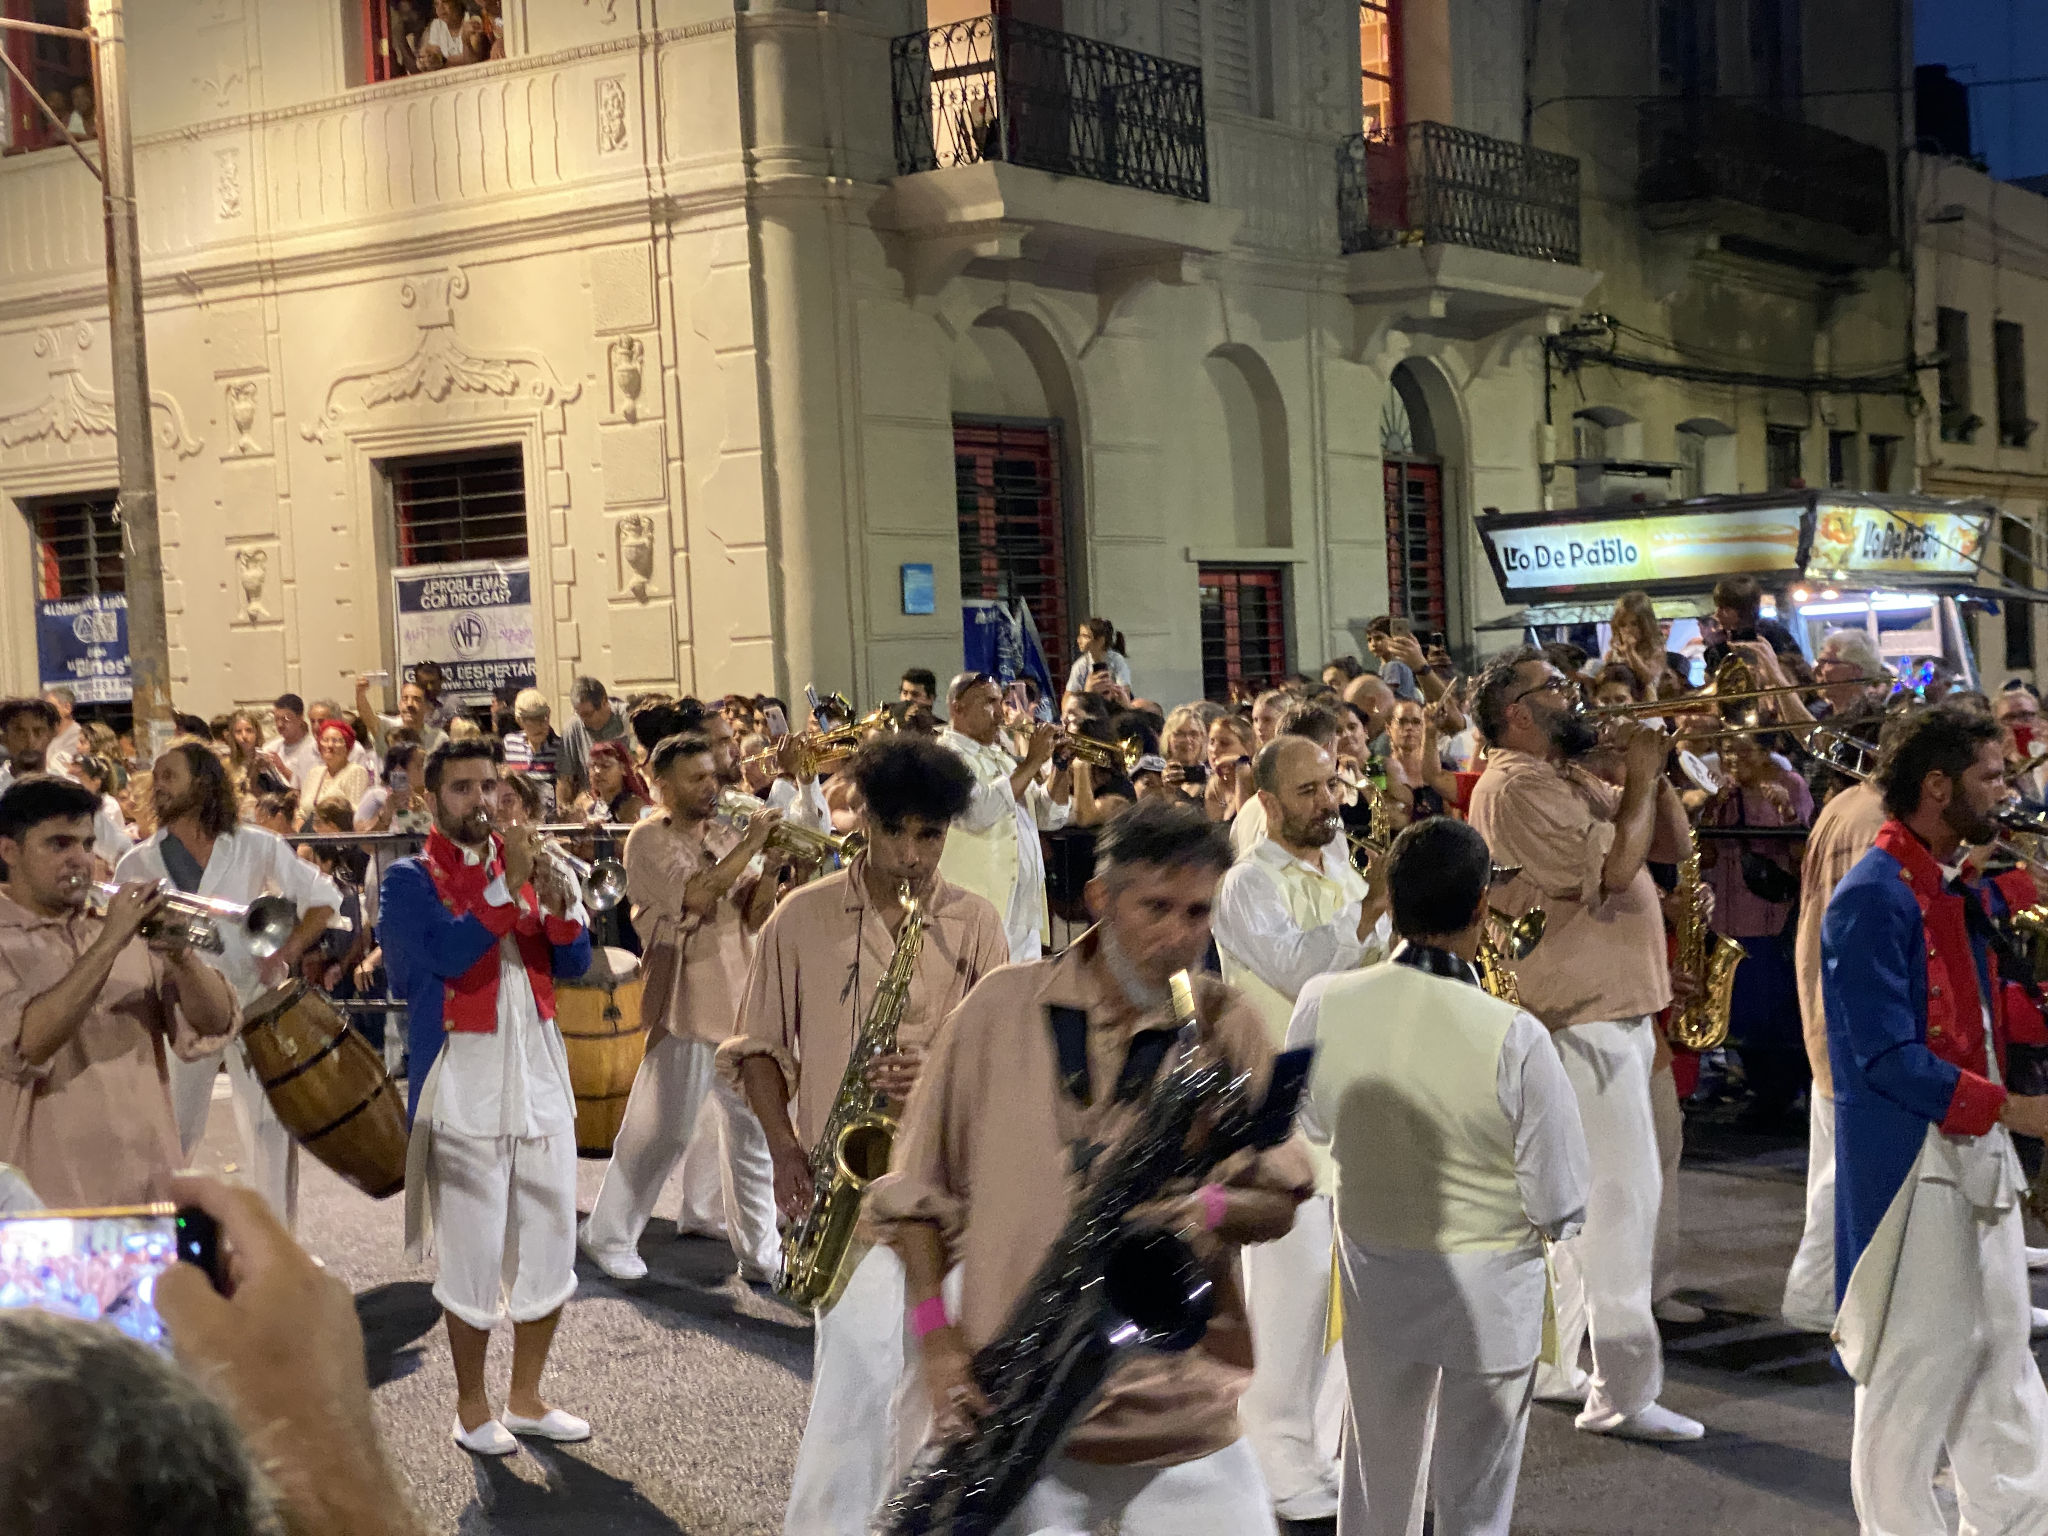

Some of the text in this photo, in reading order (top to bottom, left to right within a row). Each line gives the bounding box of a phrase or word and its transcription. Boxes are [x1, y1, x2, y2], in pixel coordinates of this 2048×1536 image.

[1535, 545, 1566, 568] De
[1569, 538, 1638, 567] Pablo
[423, 575, 509, 596] ¿PROBLEMAS
[457, 662, 536, 680] DESPERTAR
